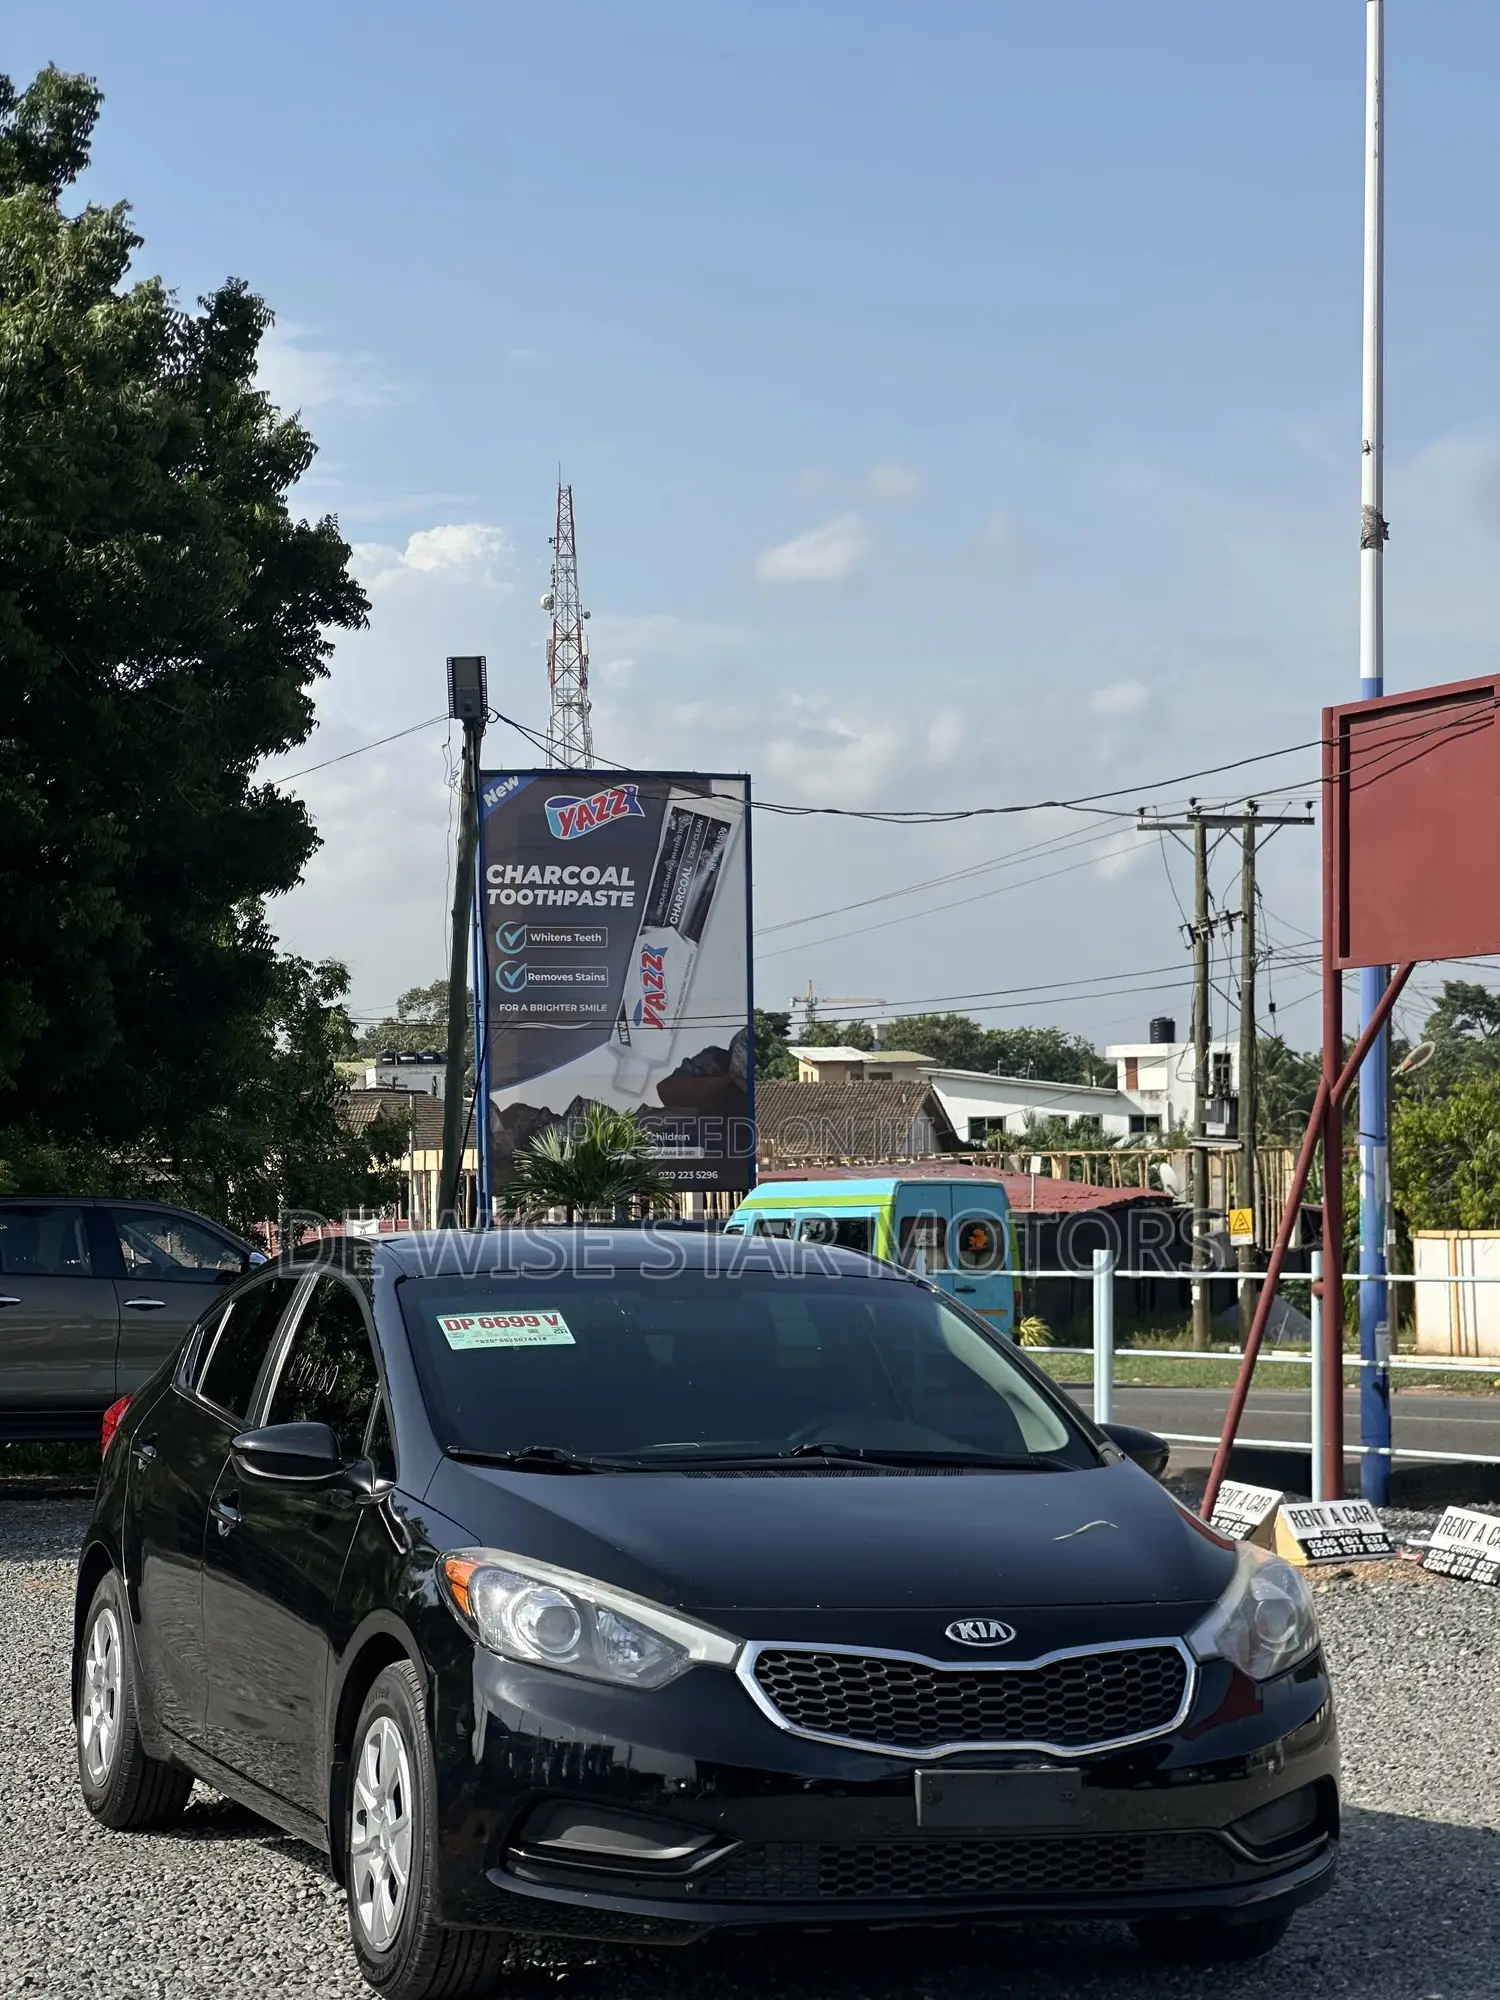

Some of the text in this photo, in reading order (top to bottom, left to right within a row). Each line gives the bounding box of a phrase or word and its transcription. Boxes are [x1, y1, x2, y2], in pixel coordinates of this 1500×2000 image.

[483, 775, 519, 807] New
[557, 788, 630, 837] YAZZ
[486, 864, 635, 887] CHARCOAL
[669, 819, 703, 924] CHARCOAL DEEP CLEAN
[487, 888, 635, 907] TOOTHPASTE
[530, 933, 602, 942] Whitens Teeth
[528, 972, 606, 982] Removes Stains
[641, 951, 666, 1030] YAZZ
[499, 1003, 608, 1012] FOR A BRIGHTER SMILE
[618, 1021, 629, 1043] NEW
[678, 1171, 694, 1179] 223
[695, 1171, 718, 1179] 5296
[443, 1314, 560, 1331] DP 6699 V
[1235, 1493, 1250, 1508] A
[1246, 1494, 1272, 1513] CAR
[1288, 1505, 1375, 1528] RENT A CAR
[1438, 1515, 1477, 1540] RENT
[1472, 1523, 1487, 1543] A
[1307, 1534, 1383, 1549] 0246 101 637
[1311, 1542, 1390, 1557] 0204 677 888
[1428, 1549, 1499, 1573] 0246 101 637
[1450, 1545, 1487, 1558] CONTACT
[1423, 1558, 1451, 1573] 0204
[1450, 1564, 1472, 1577] 677
[956, 1621, 1008, 1639] KIA
